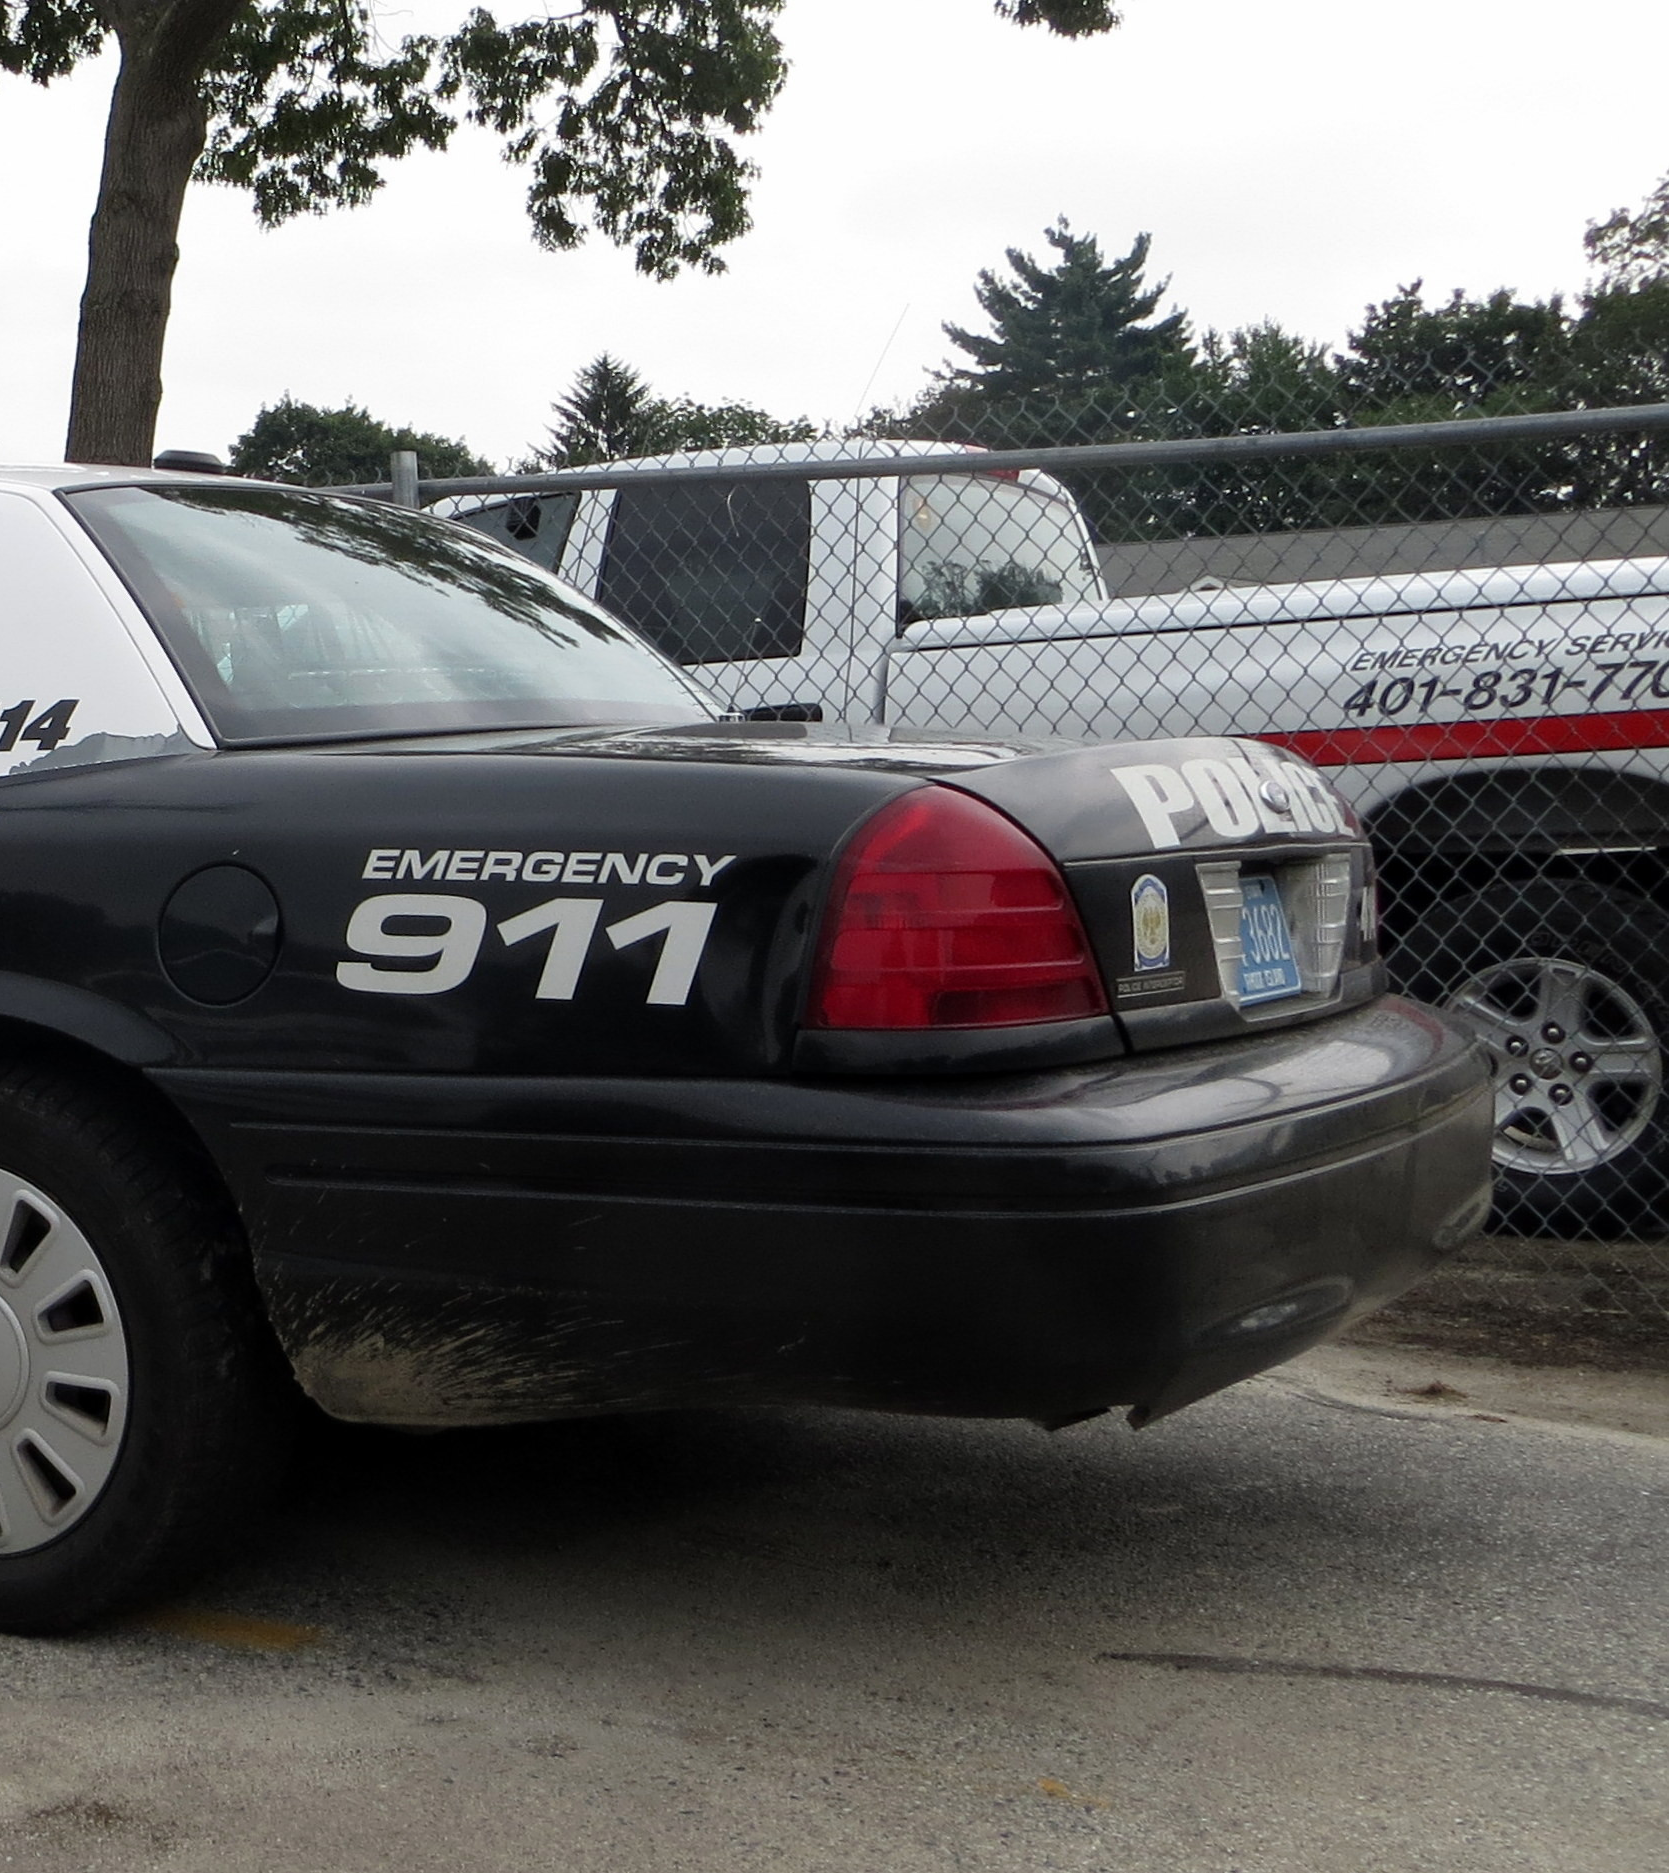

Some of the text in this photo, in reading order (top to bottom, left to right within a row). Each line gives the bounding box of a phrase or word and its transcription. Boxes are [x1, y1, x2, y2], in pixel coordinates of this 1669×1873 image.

[1351, 630, 1669, 672] EMERGENCY SERVI
[1110, 757, 1356, 849] POLICE
[362, 848, 737, 887] EMERGENCY
[336, 893, 718, 1006] 911
[1241, 903, 1291, 968] 3682
